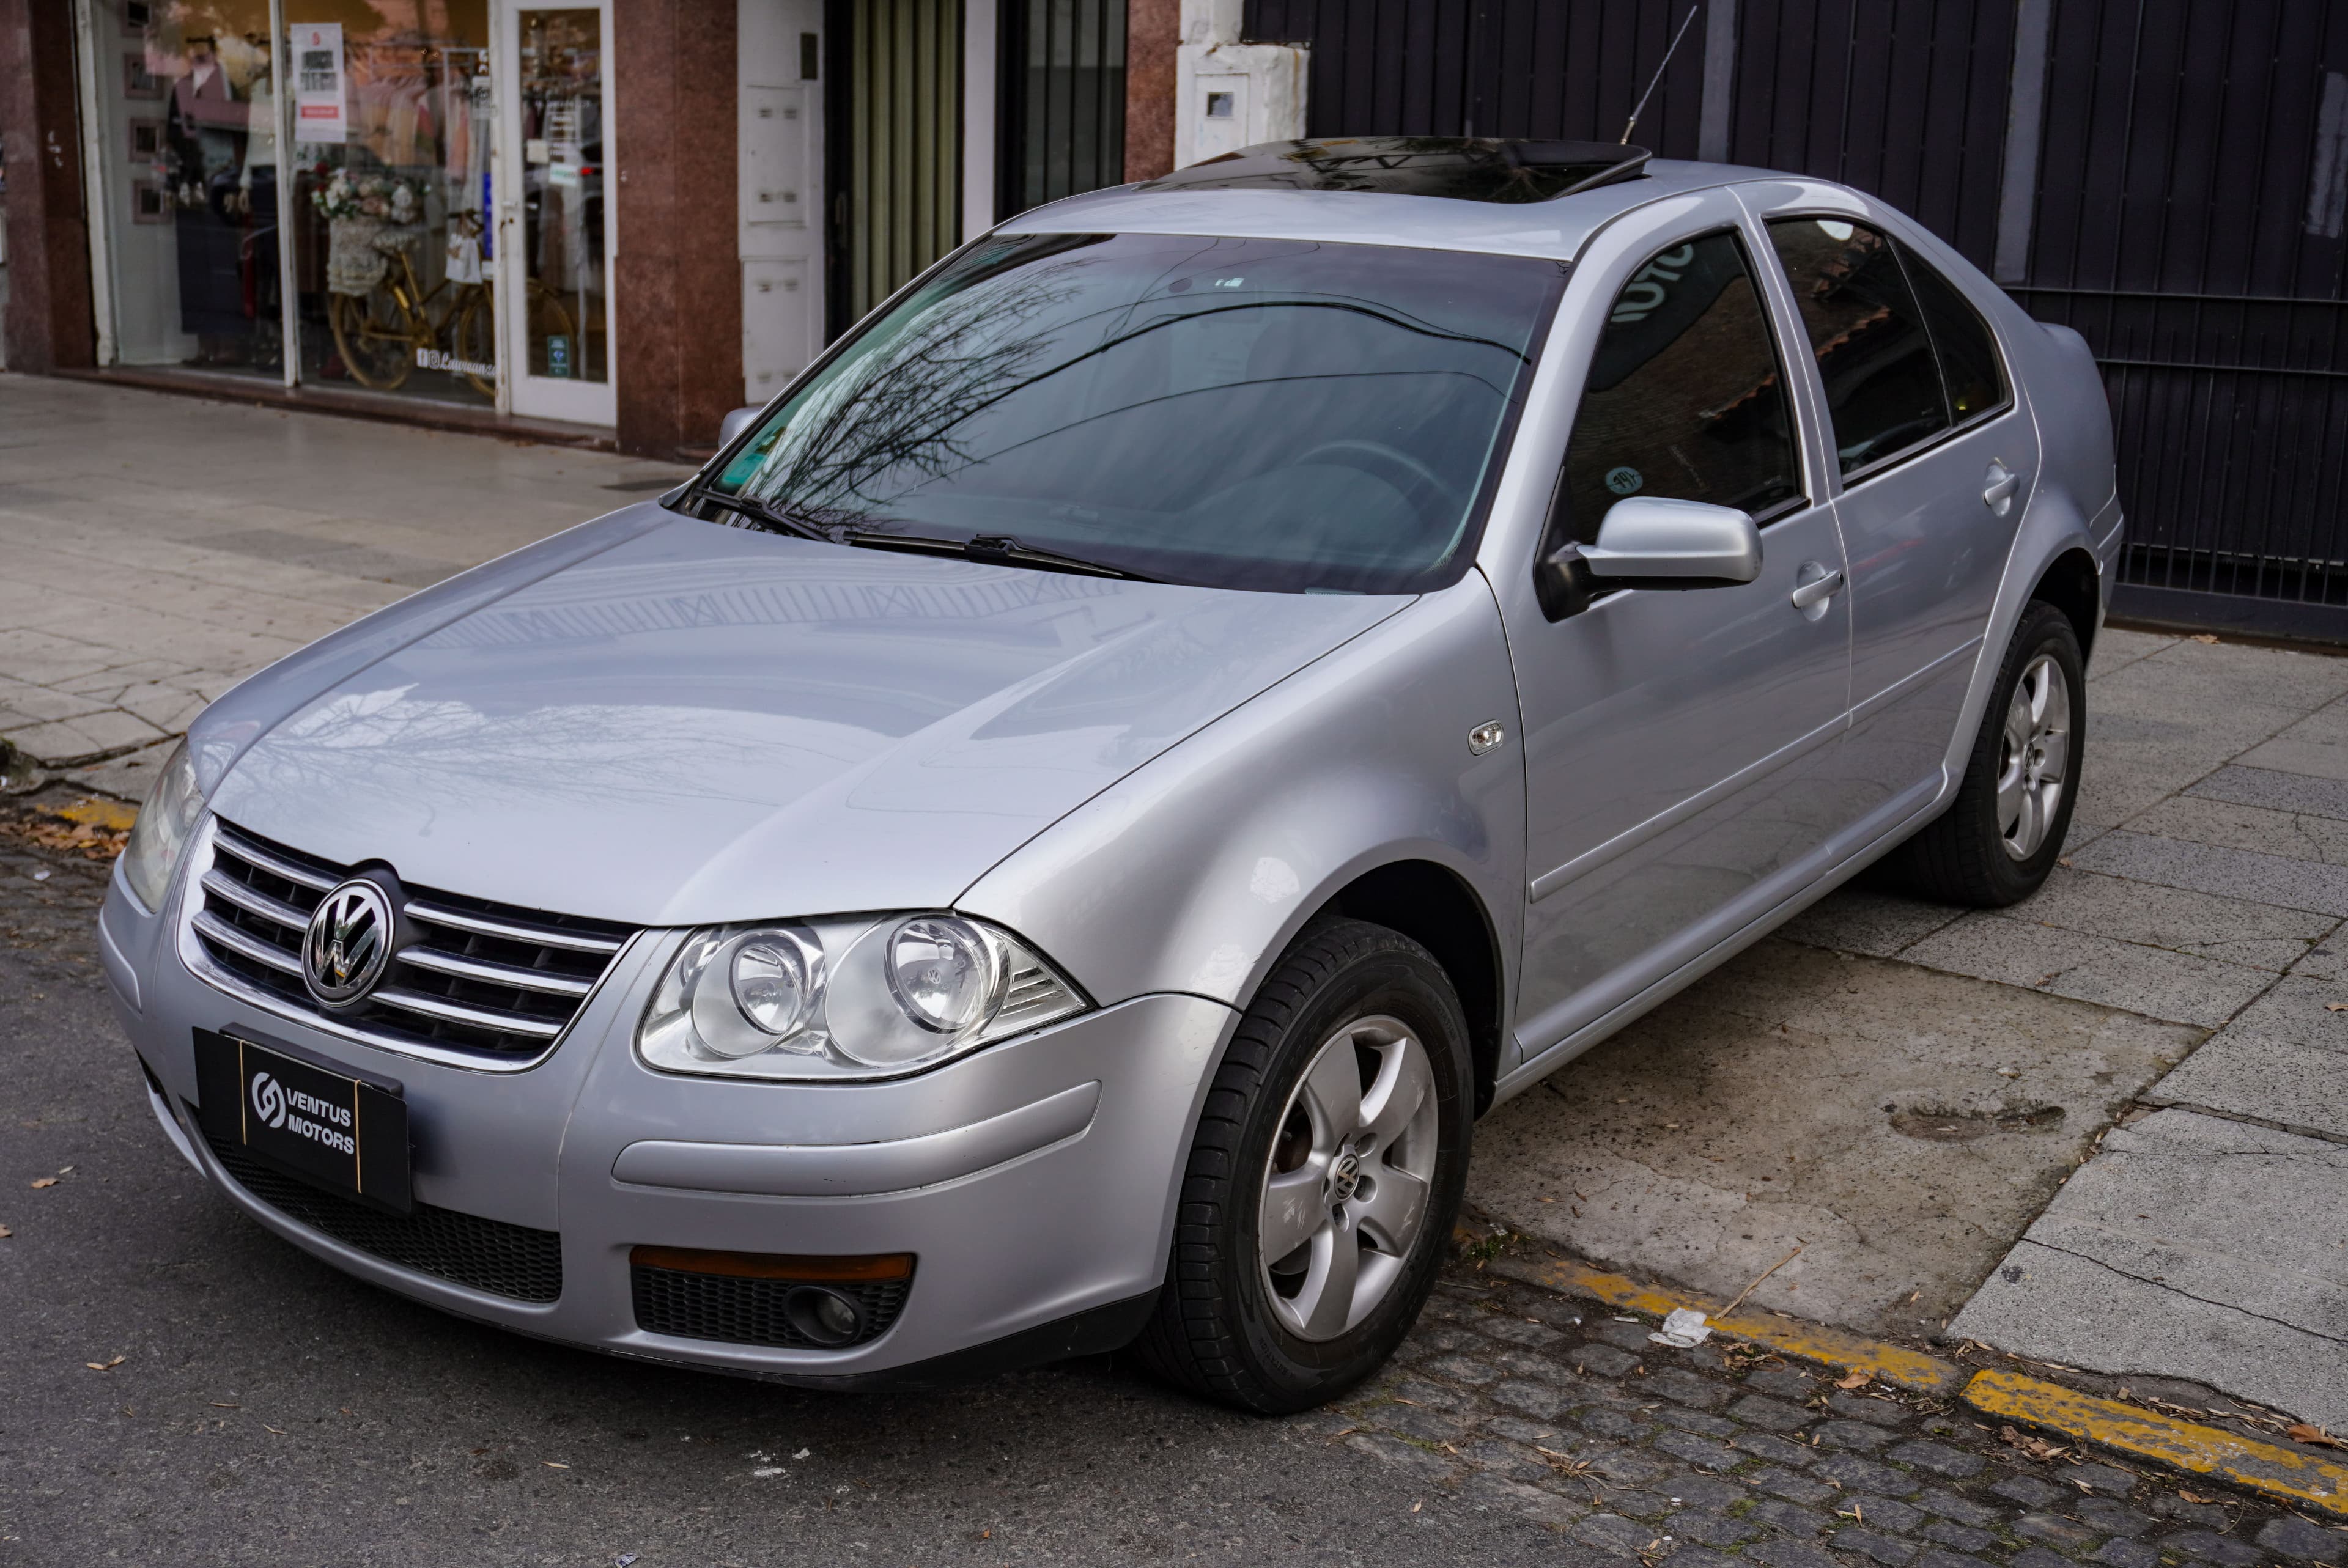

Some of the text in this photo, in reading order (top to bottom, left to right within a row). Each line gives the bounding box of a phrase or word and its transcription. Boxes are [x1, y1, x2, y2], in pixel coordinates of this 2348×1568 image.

[306, 884, 391, 1003] VW
[286, 1086, 352, 1128] VENTUS
[287, 1113, 355, 1155] MOTORS
[1335, 1156, 1359, 1198] VW
